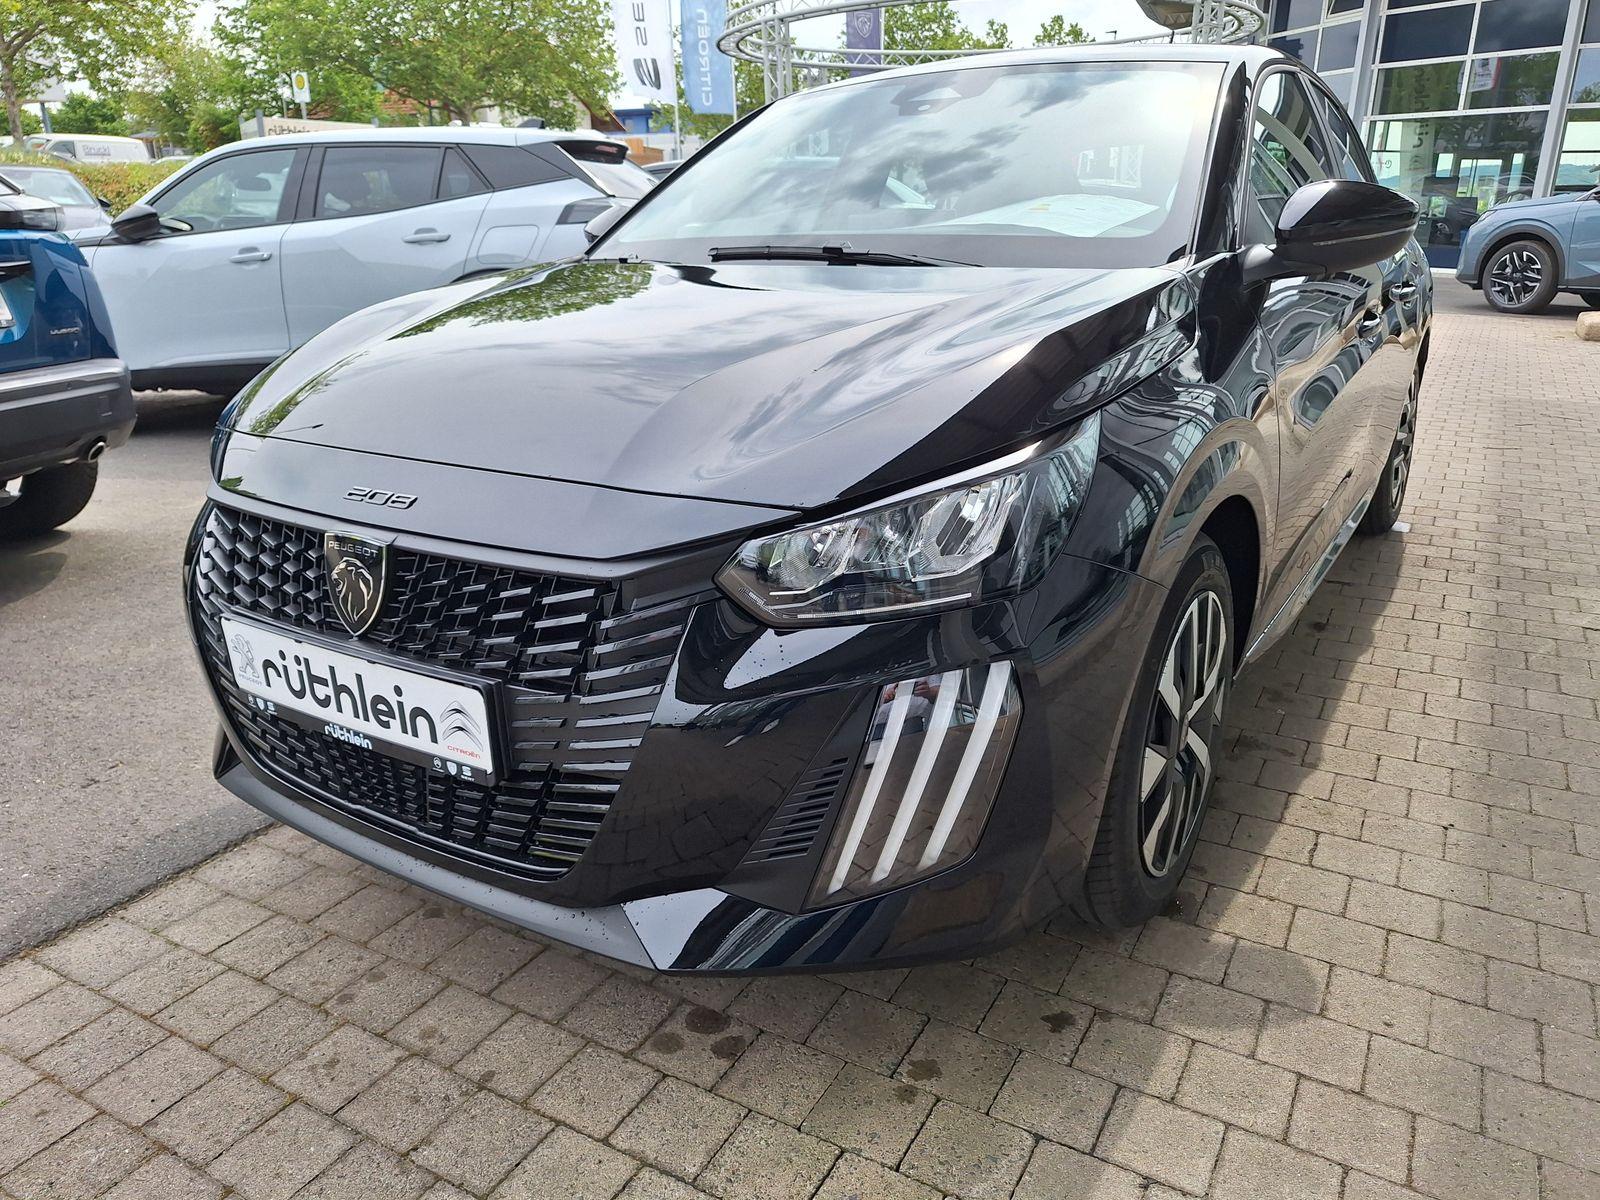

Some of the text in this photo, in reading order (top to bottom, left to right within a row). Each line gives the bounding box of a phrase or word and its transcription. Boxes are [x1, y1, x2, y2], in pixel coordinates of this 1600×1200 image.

[343, 486, 418, 510] 208
[328, 541, 379, 557] PEUGEOT
[261, 649, 439, 744] rüthlein
[324, 723, 373, 750] rüthlein
